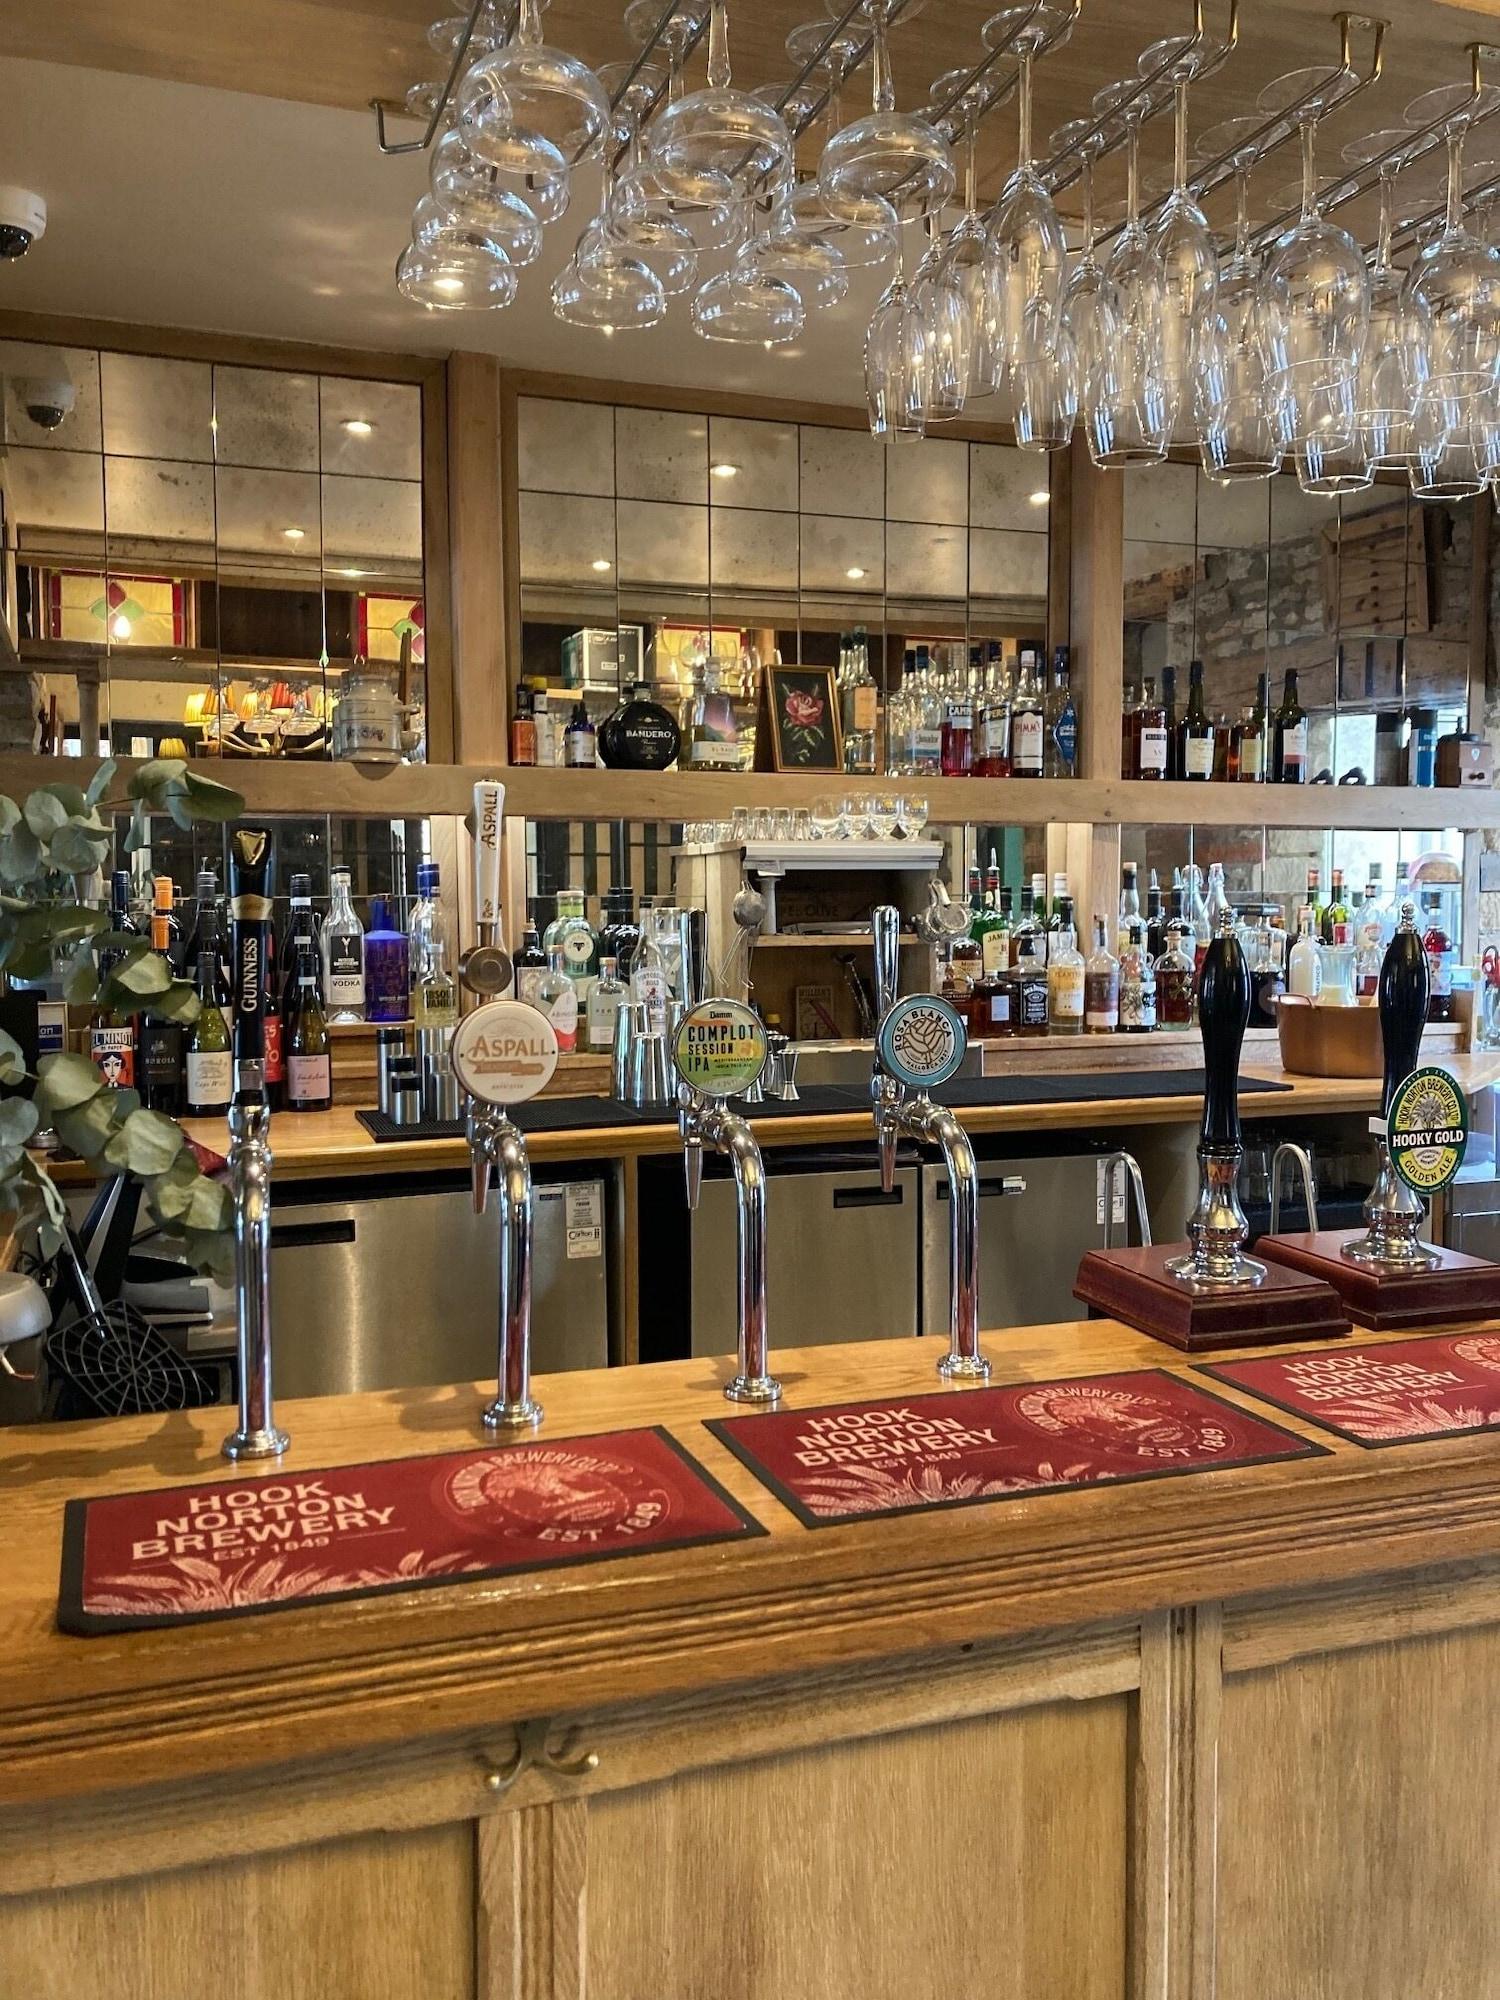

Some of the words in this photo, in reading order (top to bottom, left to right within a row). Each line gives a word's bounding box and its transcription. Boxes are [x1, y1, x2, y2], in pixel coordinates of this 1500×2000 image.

[625, 730, 672, 738] BANDERO
[481, 790, 498, 851] ASPALL
[241, 937, 258, 1012] GUINNESS
[332, 979, 361, 988] VODKA
[709, 1011, 733, 1019] Damm
[911, 1009, 952, 1038] BLANCA
[688, 1024, 755, 1042] COMPLOT
[894, 1019, 910, 1051] ROSA
[466, 1035, 549, 1062] ASPALL
[688, 1043, 734, 1056] SESSION
[688, 1057, 710, 1072] IPA
[1403, 1079, 1427, 1106] NORTON
[1427, 1078, 1454, 1102] BREWERY
[1398, 1104, 1411, 1124] HOOK
[1392, 1132, 1433, 1148] HOOKY
[1434, 1129, 1465, 1144] GOLD
[1404, 1159, 1438, 1183] GOLDEN
[1439, 1155, 1453, 1176] ALE
[1281, 1354, 1383, 1374] HOOK
[1286, 1362, 1427, 1388] NORTON
[1036, 1387, 1112, 1400] BREWERY
[1110, 1391, 1133, 1401] CO
[1297, 1370, 1465, 1402] BREWERY
[806, 1407, 924, 1433] HOOK
[796, 1417, 966, 1450] NORTON
[1198, 1427, 1227, 1453] 1849
[488, 1449, 577, 1468] BREWERY
[794, 1428, 1001, 1467] BREWERY
[870, 1458, 908, 1469] EST
[915, 1450, 962, 1465] 1849
[1136, 1446, 1192, 1458] EST
[188, 1480, 332, 1514] HOOK
[155, 1493, 368, 1537] NORTON
[615, 1502, 662, 1535] 1849
[132, 1506, 396, 1561] BREWERY
[538, 1527, 603, 1543] EST
[212, 1546, 261, 1562] EST
[269, 1535, 330, 1554] 1849
